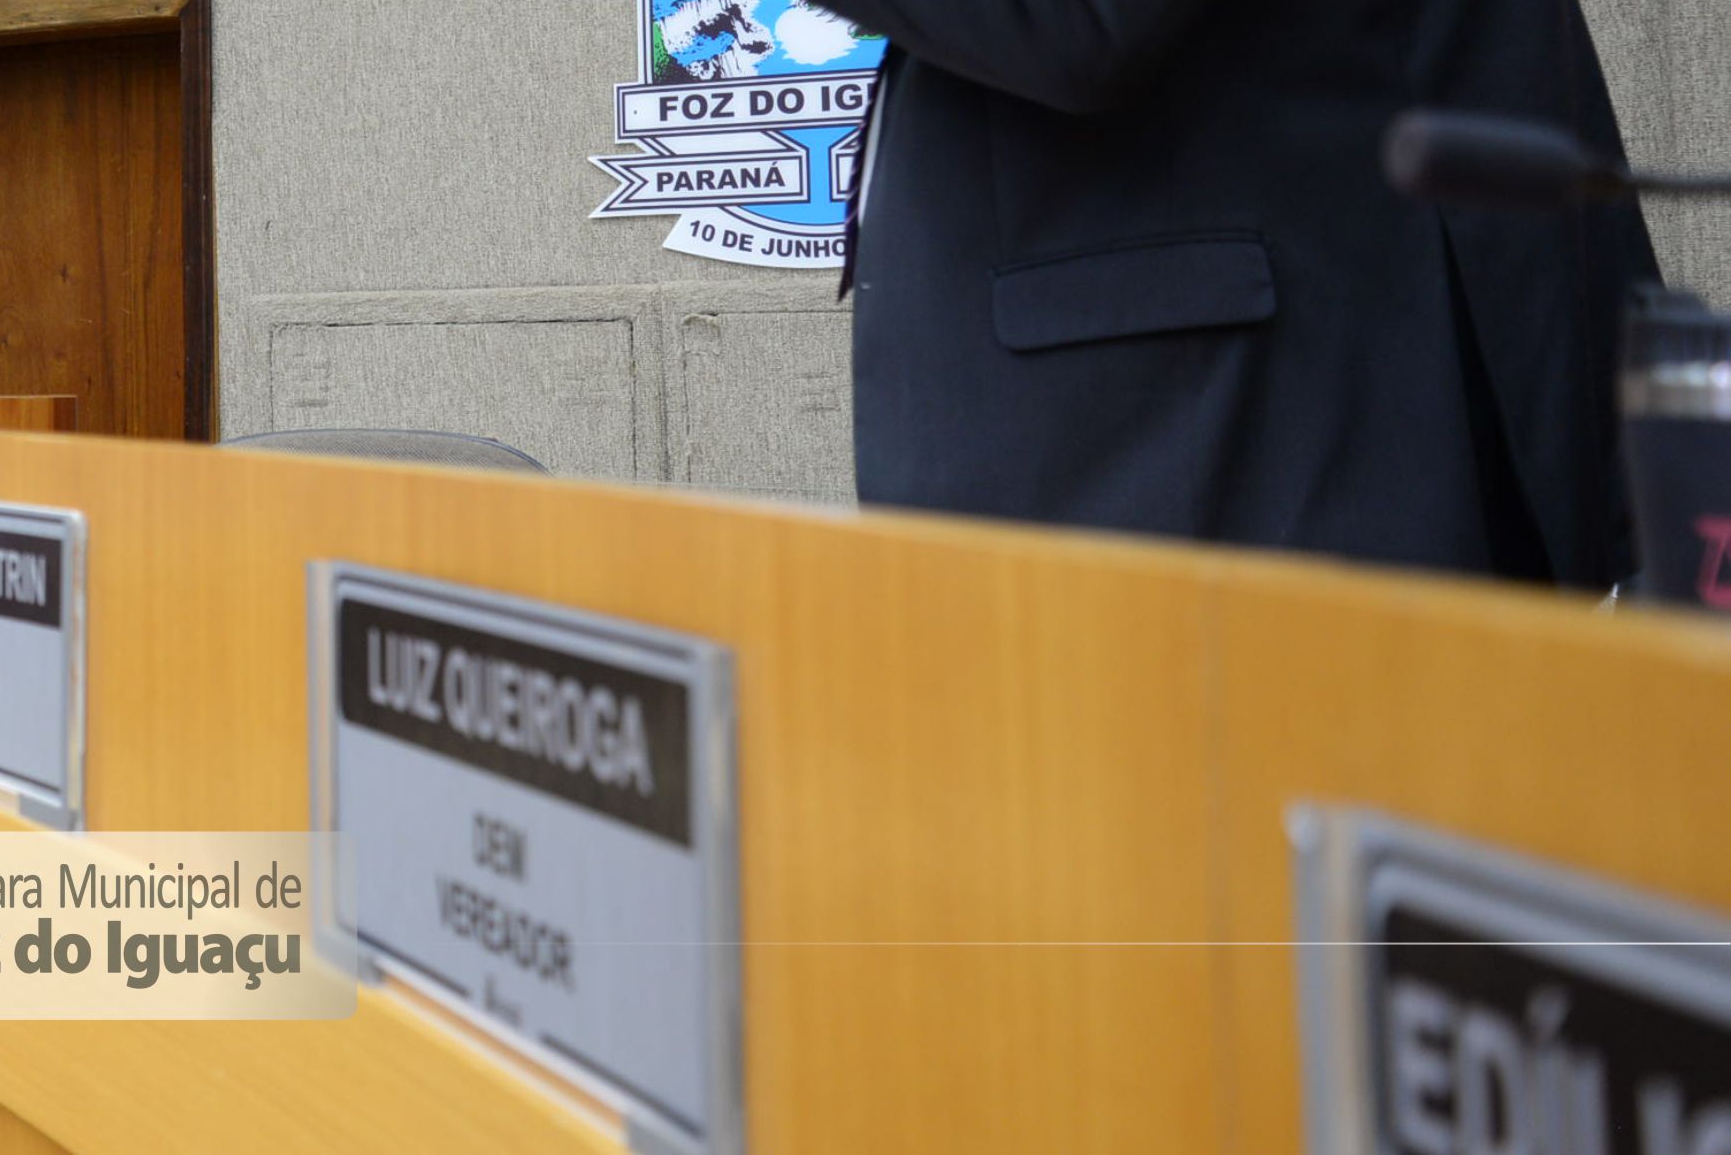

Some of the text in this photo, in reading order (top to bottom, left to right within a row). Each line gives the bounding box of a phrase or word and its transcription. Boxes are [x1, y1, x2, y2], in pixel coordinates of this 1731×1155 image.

[659, 92, 735, 121] FOZ
[749, 87, 805, 116] DO
[656, 161, 786, 192] PARANÁ
[690, 220, 846, 258] 10 DE JUNHO
[444, 648, 654, 797] QUEIROGA
[435, 872, 575, 994] VEREADOR
